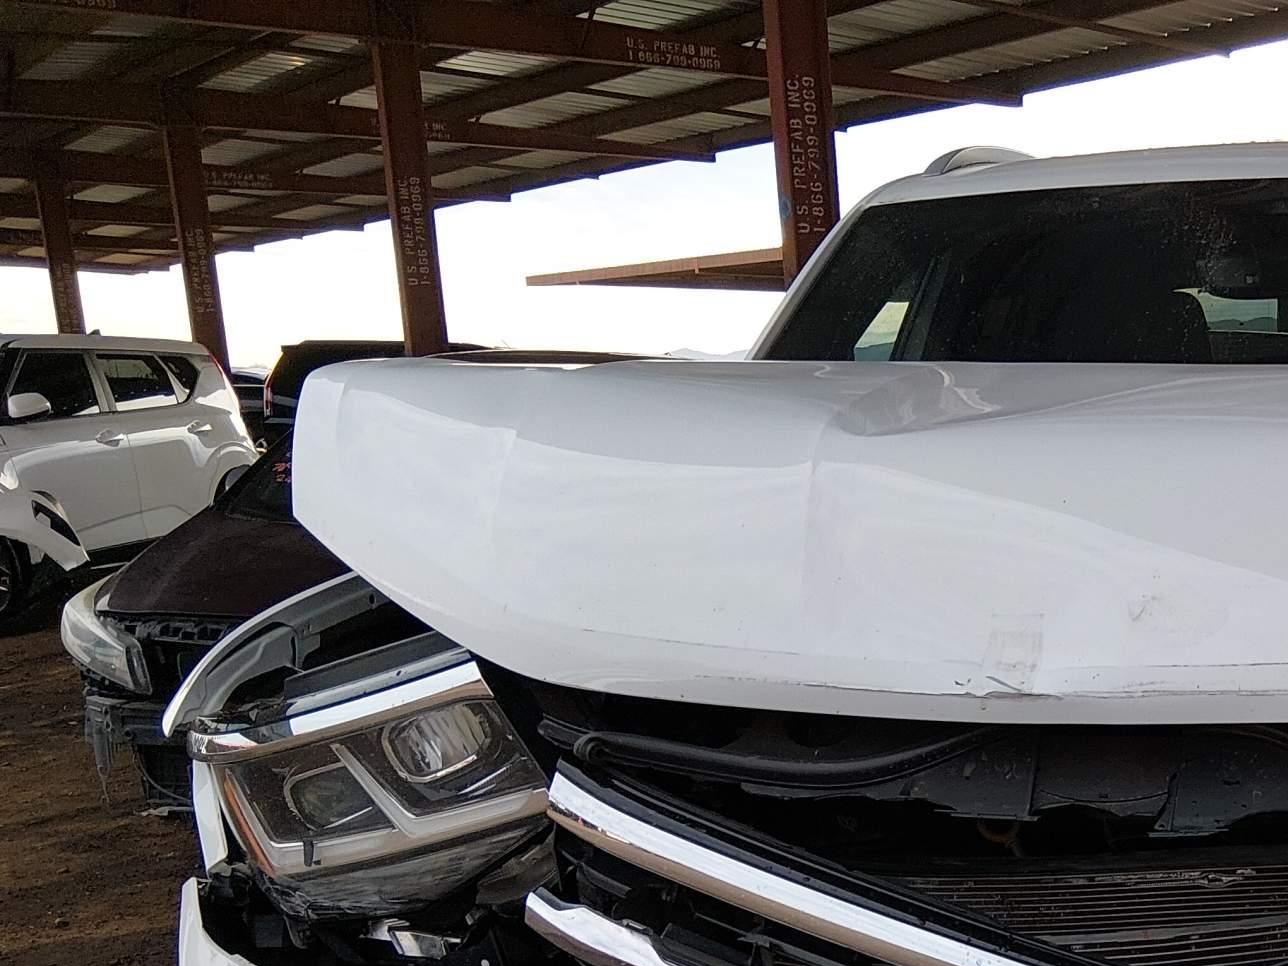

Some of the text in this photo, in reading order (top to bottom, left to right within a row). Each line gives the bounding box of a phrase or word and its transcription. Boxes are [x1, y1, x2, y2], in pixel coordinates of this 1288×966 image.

[653, 40, 696, 56] PREFAB
[786, 74, 811, 234] U.S. PREFAB INC.
[801, 75, 826, 233] 1-866-799-0969
[400, 205, 415, 256] PREFAB
